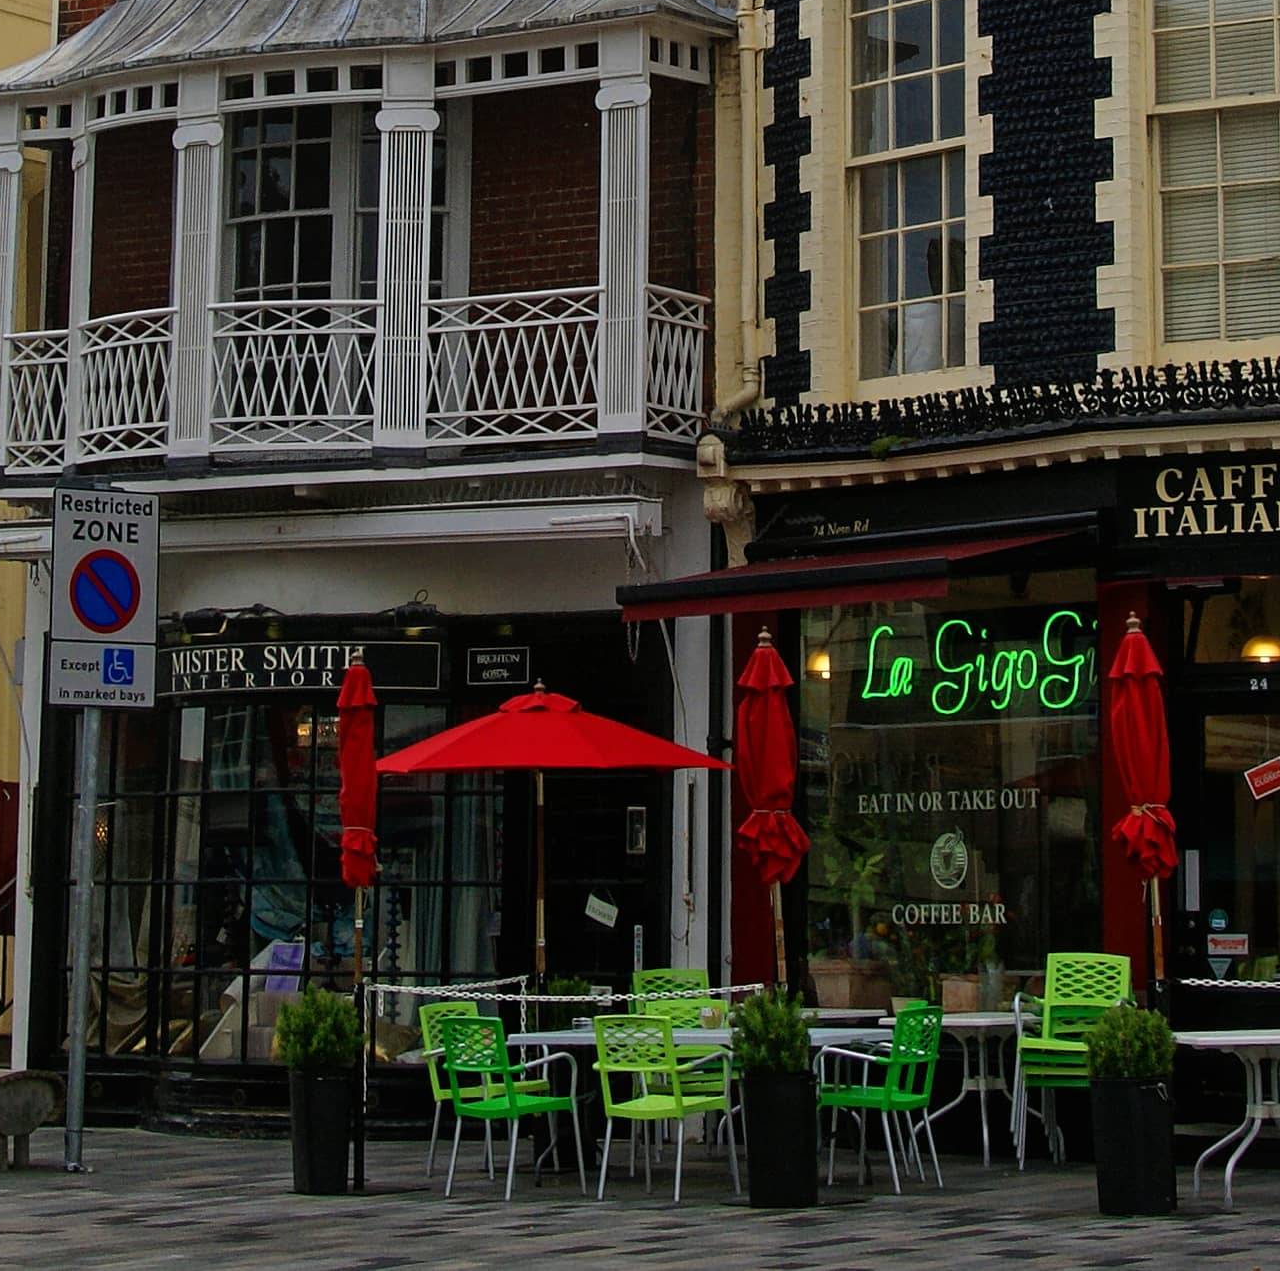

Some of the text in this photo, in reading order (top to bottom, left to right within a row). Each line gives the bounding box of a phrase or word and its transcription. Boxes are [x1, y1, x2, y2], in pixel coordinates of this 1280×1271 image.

[61, 494, 153, 516] Restricted
[73, 519, 139, 544] ZONE
[60, 658, 100, 672] Except
[172, 645, 366, 675] MISTER SMITH
[862, 625, 912, 699] La
[59, 687, 145, 703] in marked bays
[1250, 678, 1268, 690] 24
[858, 788, 1041, 814] EAT IN OR TAKE OUT
[891, 903, 1008, 926] COFFEE BAR
